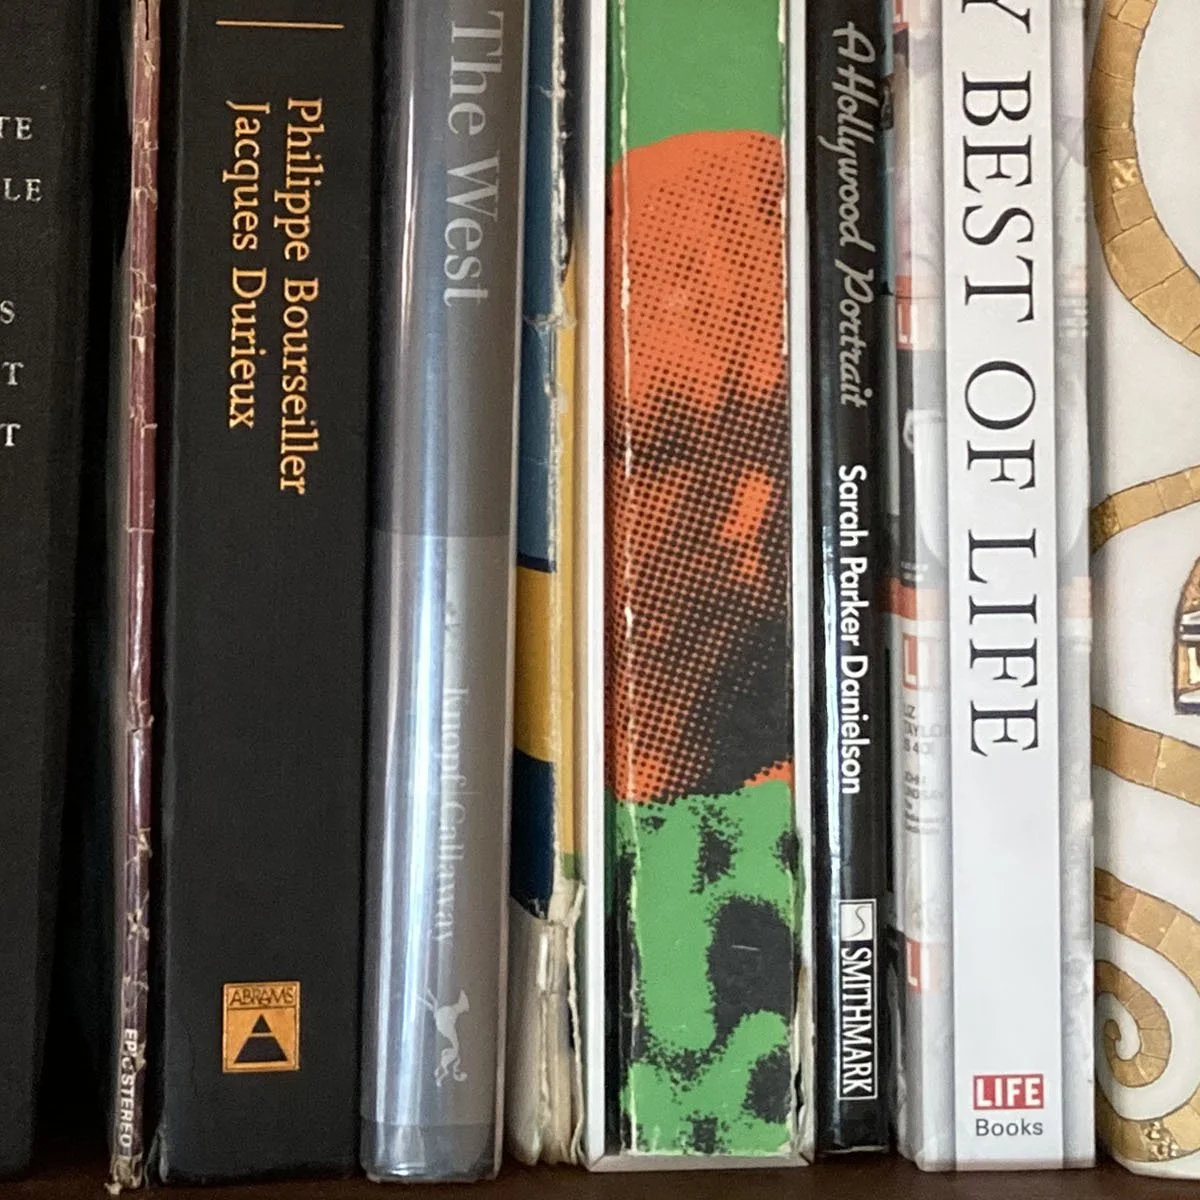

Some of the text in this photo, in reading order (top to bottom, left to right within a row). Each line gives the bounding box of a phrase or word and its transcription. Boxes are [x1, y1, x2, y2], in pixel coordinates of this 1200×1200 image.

[447, 10, 505, 137] The
[222, 100, 270, 429] Jacques Durieux
[443, 156, 499, 308] West
[817, 21, 880, 408] A Hollywood Portrait
[961, 71, 1035, 323] BEST
[274, 98, 325, 495] Philippe Bourseiller
[964, 360, 1036, 490] OF
[838, 464, 870, 795] Sarah Parker Danielson
[967, 528, 1040, 757] LIFE
[436, 686, 470, 786] Knopf
[230, 987, 295, 1006] ABRAMS
[840, 946, 873, 1095] SMITHMARK
[118, 1071, 136, 1148] STEREO
[974, 1076, 1043, 1108] LIFE
[975, 1118, 1044, 1136] Books
